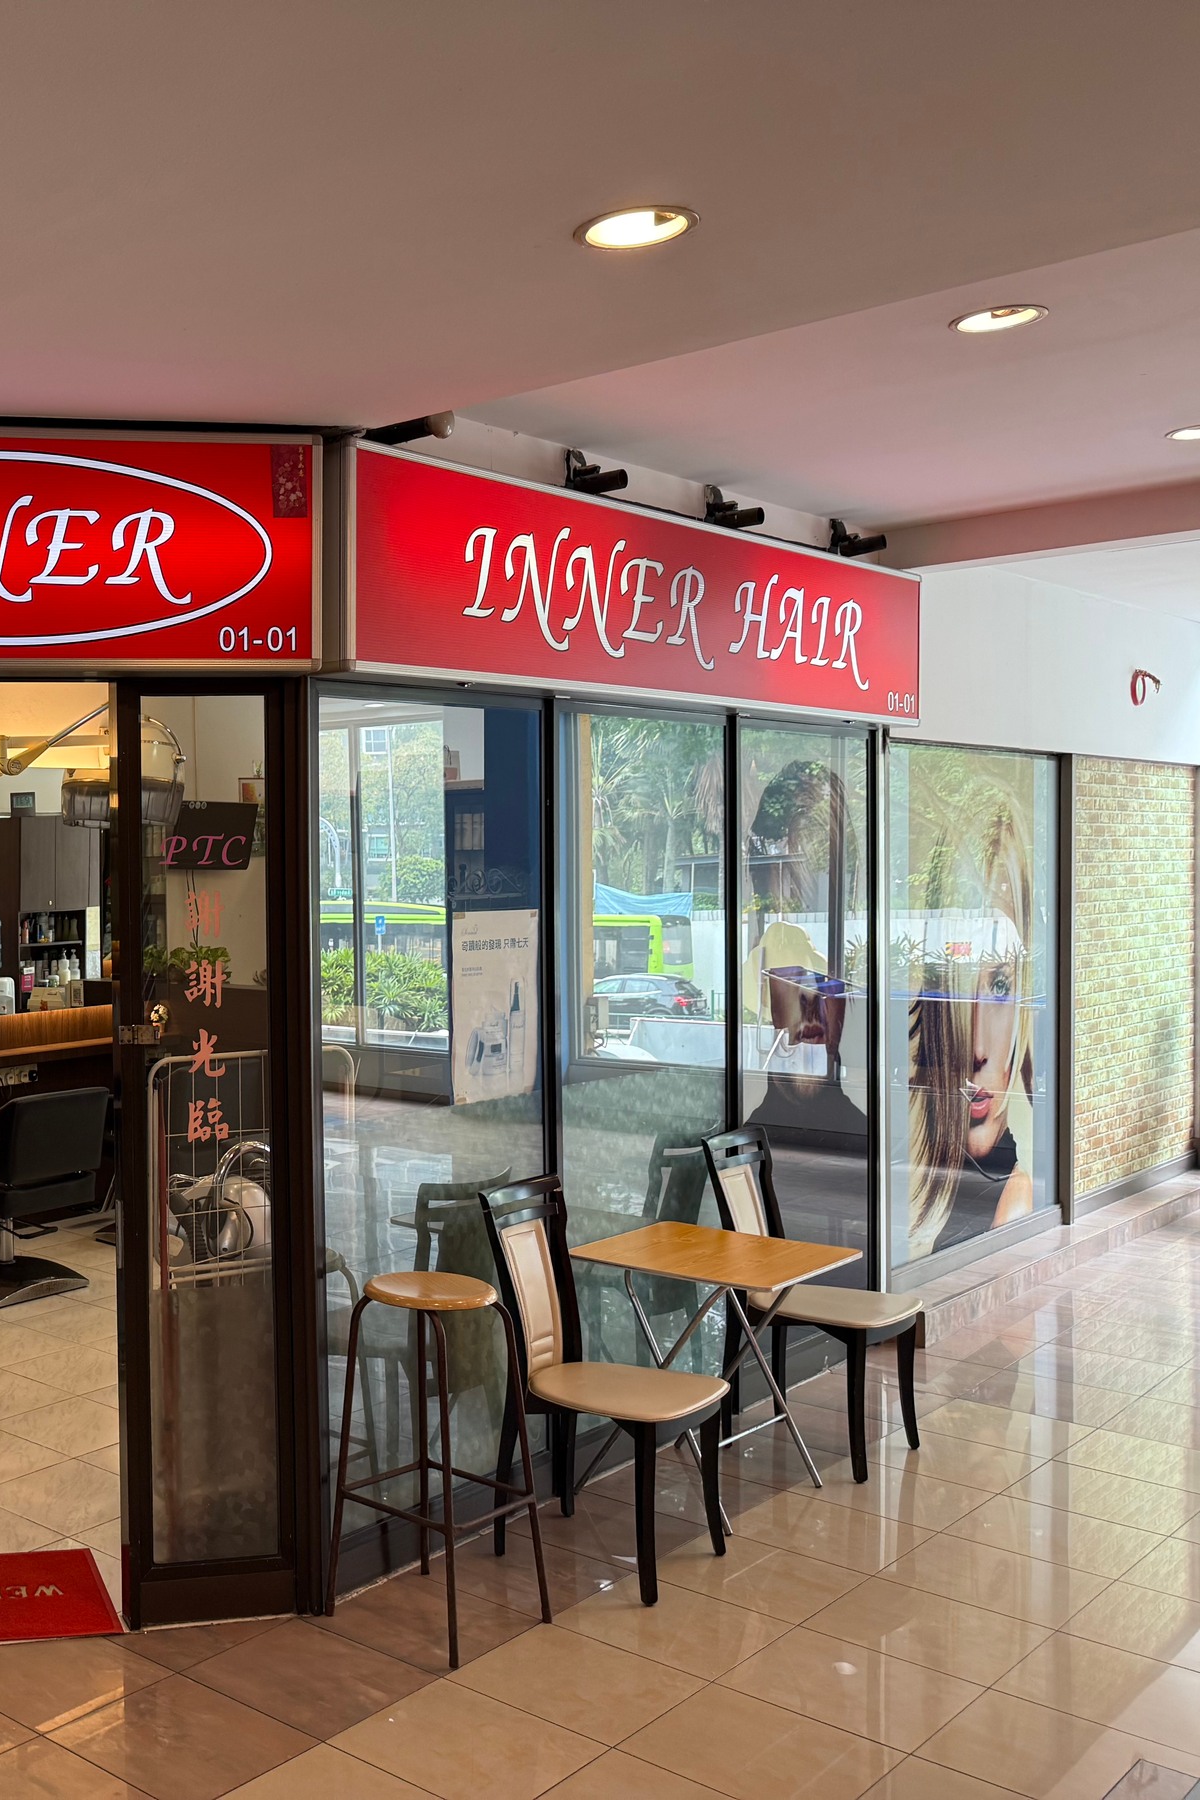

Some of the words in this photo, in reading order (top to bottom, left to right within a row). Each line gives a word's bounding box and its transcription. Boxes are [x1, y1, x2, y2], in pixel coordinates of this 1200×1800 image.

[462, 527, 715, 670] INNER
[729, 574, 870, 691] HAIR
[218, 626, 299, 653] 01-01
[887, 691, 916, 715] 01-01
[158, 834, 248, 866] PTC
[184, 890, 230, 1143] 謝謝光臨
